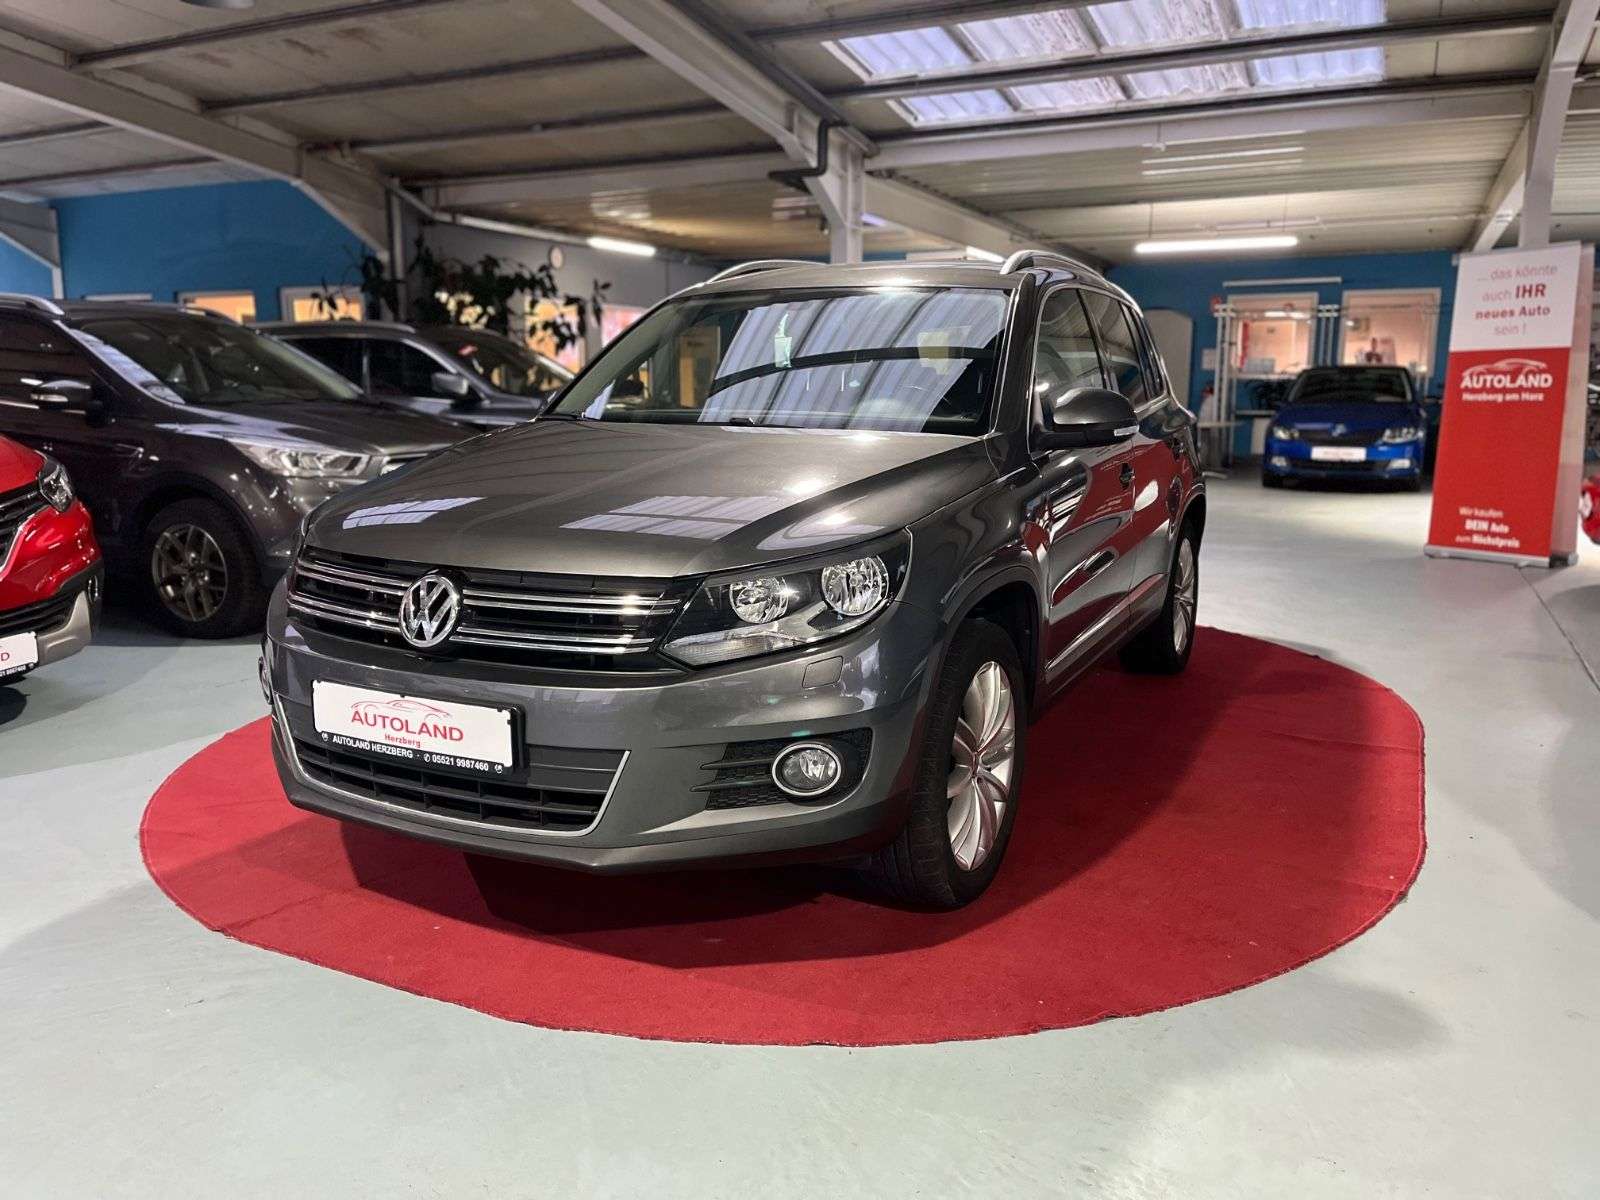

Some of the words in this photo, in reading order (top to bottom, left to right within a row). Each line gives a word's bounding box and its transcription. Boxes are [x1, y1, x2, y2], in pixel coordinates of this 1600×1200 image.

[1491, 268, 1513, 281] das
[1515, 264, 1558, 278] könnte
[1482, 290, 1512, 302] auch
[1515, 283, 1547, 299] IHR
[1475, 309, 1515, 320] neues
[1519, 305, 1551, 317] Auto
[1494, 325, 1519, 336] sein
[1460, 373, 1553, 389] AUTOLAND
[351, 710, 464, 742] AUTOLAND
[384, 734, 421, 748] Herzberg
[332, 735, 371, 751] AUTOLAND
[371, 742, 414, 759] HERZBERG
[431, 754, 455, 766] 05521
